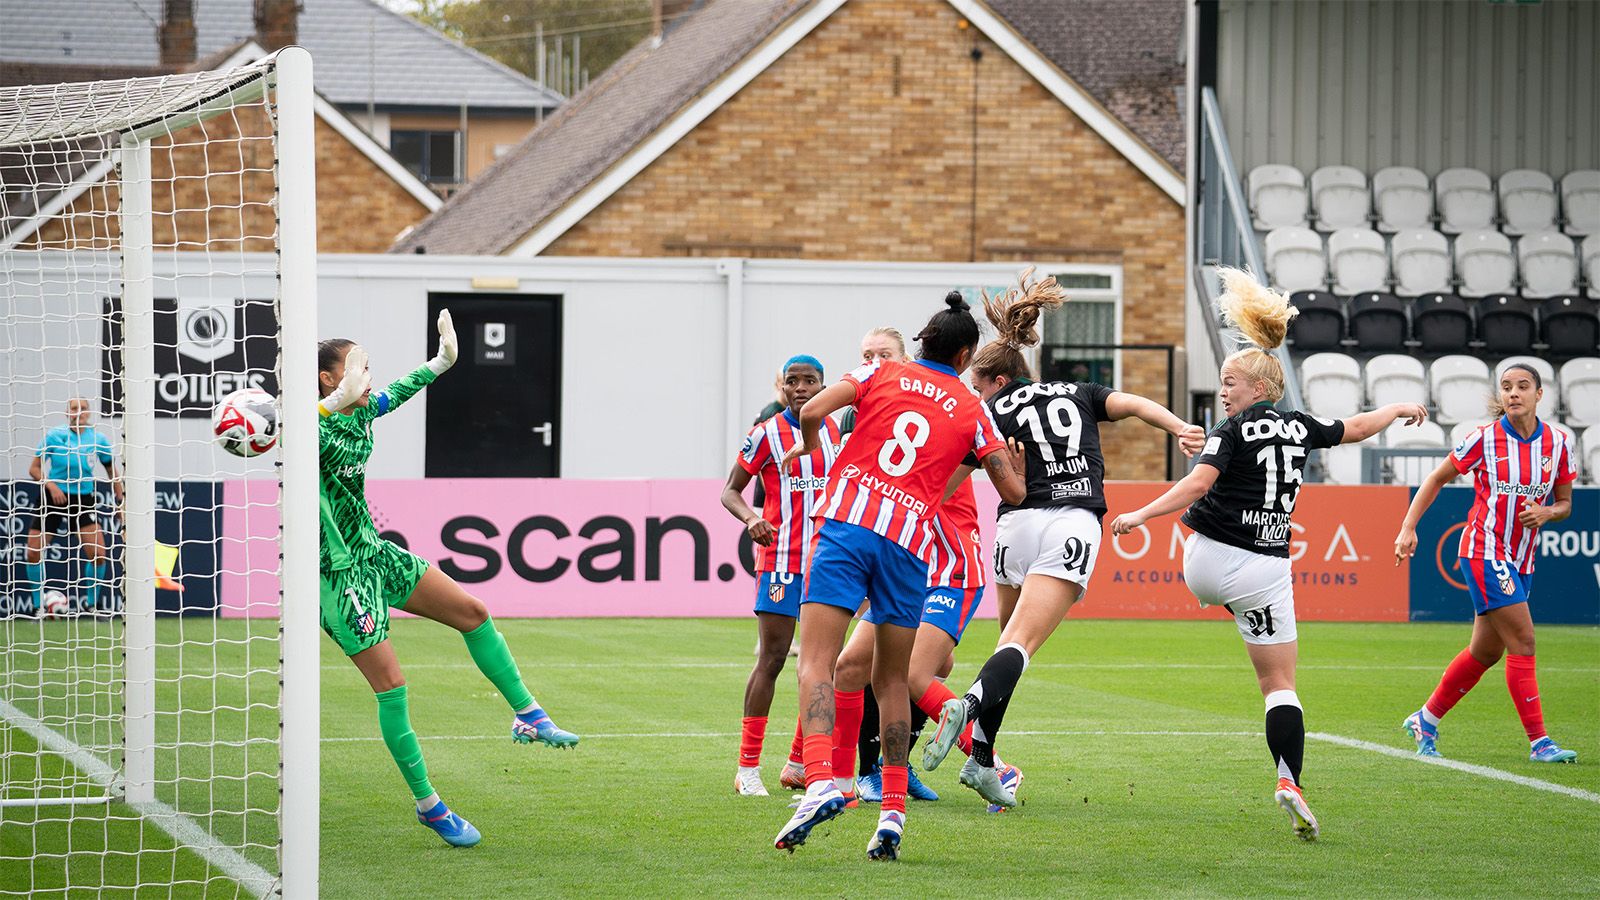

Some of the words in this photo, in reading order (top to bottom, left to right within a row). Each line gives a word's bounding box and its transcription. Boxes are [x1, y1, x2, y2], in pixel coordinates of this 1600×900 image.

[154, 373, 266, 404] OILETS
[899, 376, 948, 404] GABY
[942, 391, 958, 418] G.
[877, 410, 930, 477] 8
[1016, 397, 1082, 462] 19
[860, 472, 929, 517] HYUNDAI
[1256, 445, 1306, 513] 15
[1496, 481, 1545, 497] Herbalife
[437, 514, 757, 583] scan.
[1491, 559, 1511, 580] 9
[345, 587, 363, 615] 1
[927, 594, 956, 609] BAXI
